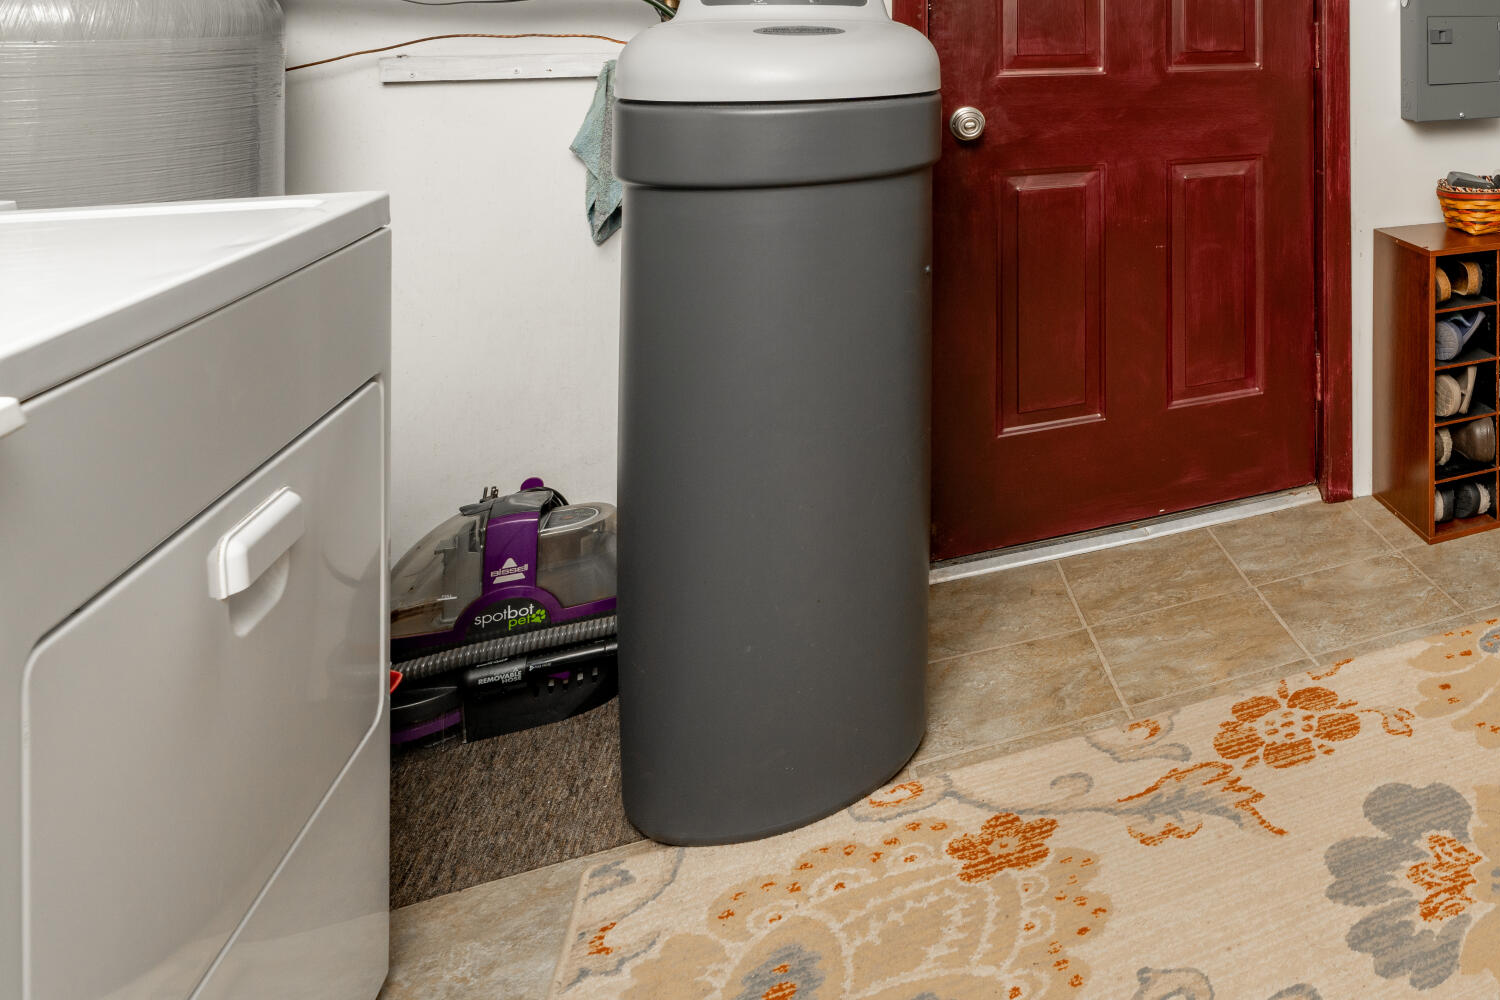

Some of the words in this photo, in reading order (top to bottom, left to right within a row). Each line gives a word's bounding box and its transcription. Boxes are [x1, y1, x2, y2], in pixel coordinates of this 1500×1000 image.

[474, 604, 534, 629] spotbot
[508, 615, 531, 631] pet
[478, 670, 522, 685] REMOVABLE
